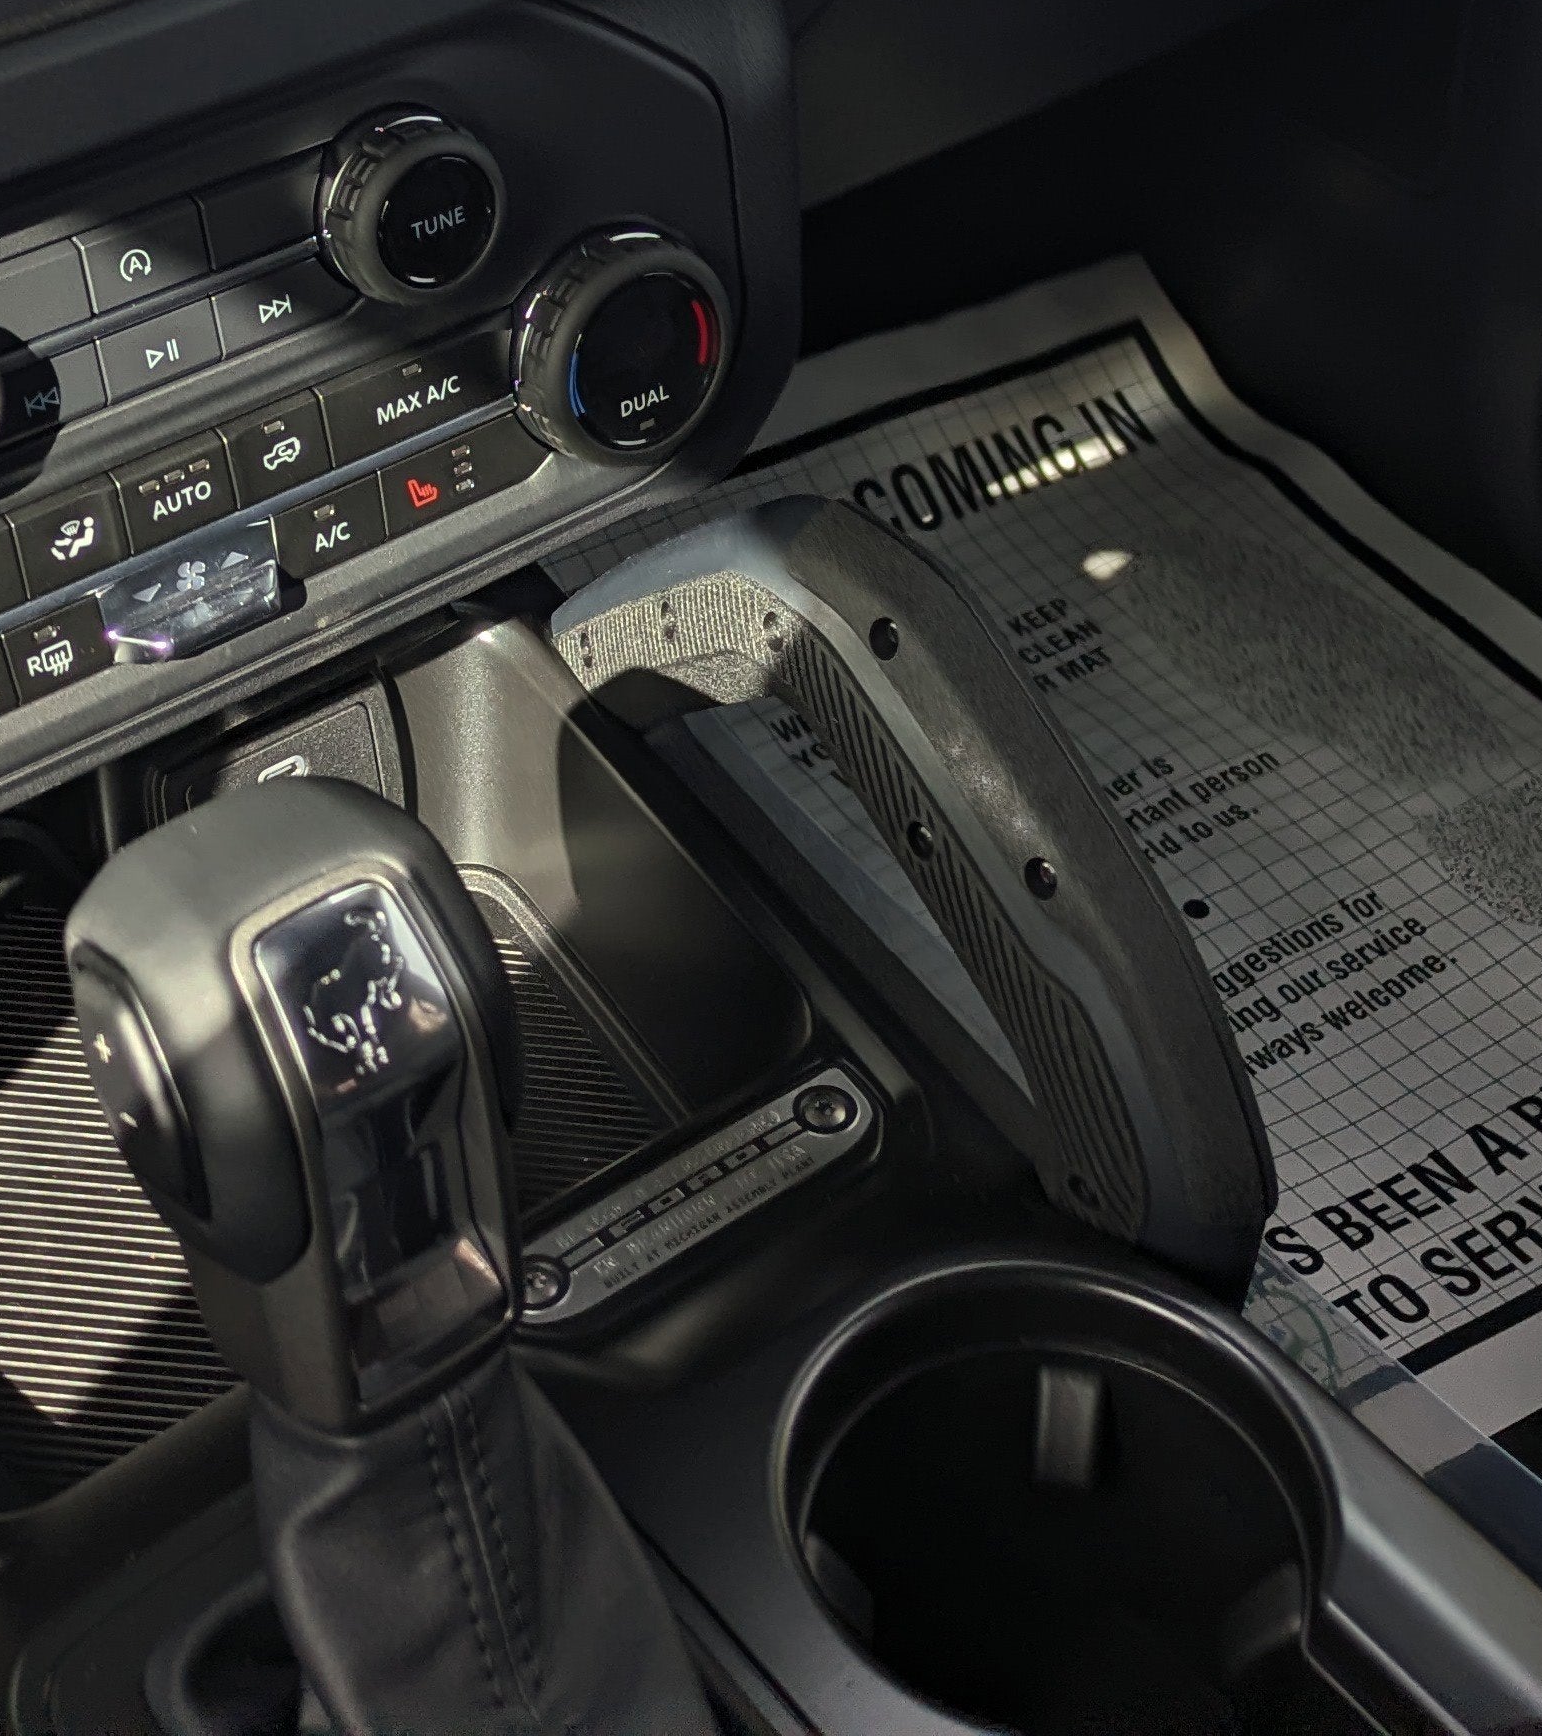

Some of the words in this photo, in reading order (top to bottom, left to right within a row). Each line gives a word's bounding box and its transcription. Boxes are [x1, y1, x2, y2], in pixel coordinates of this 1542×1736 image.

[410, 205, 467, 240] TUNE
[374, 390, 425, 427] MAX
[426, 374, 462, 407] A/C
[618, 384, 672, 420] DUAL
[1076, 389, 1158, 461] IN
[151, 480, 212, 522] AUTO
[314, 520, 352, 554] A/C
[1006, 597, 1069, 637] KEEP
[1017, 616, 1103, 665] CLEAN
[1055, 644, 1113, 683] MAT
[1189, 752, 1281, 804] person
[1178, 821, 1214, 843] to
[1213, 804, 1259, 827] us.
[1337, 890, 1384, 924] for
[1277, 968, 1326, 1004] our
[1326, 917, 1427, 980] service
[1321, 954, 1458, 1032] welcome.
[1314, 1148, 1476, 1252] BEEN
[1464, 1123, 1529, 1168] A
[1332, 1274, 1431, 1342] TO
